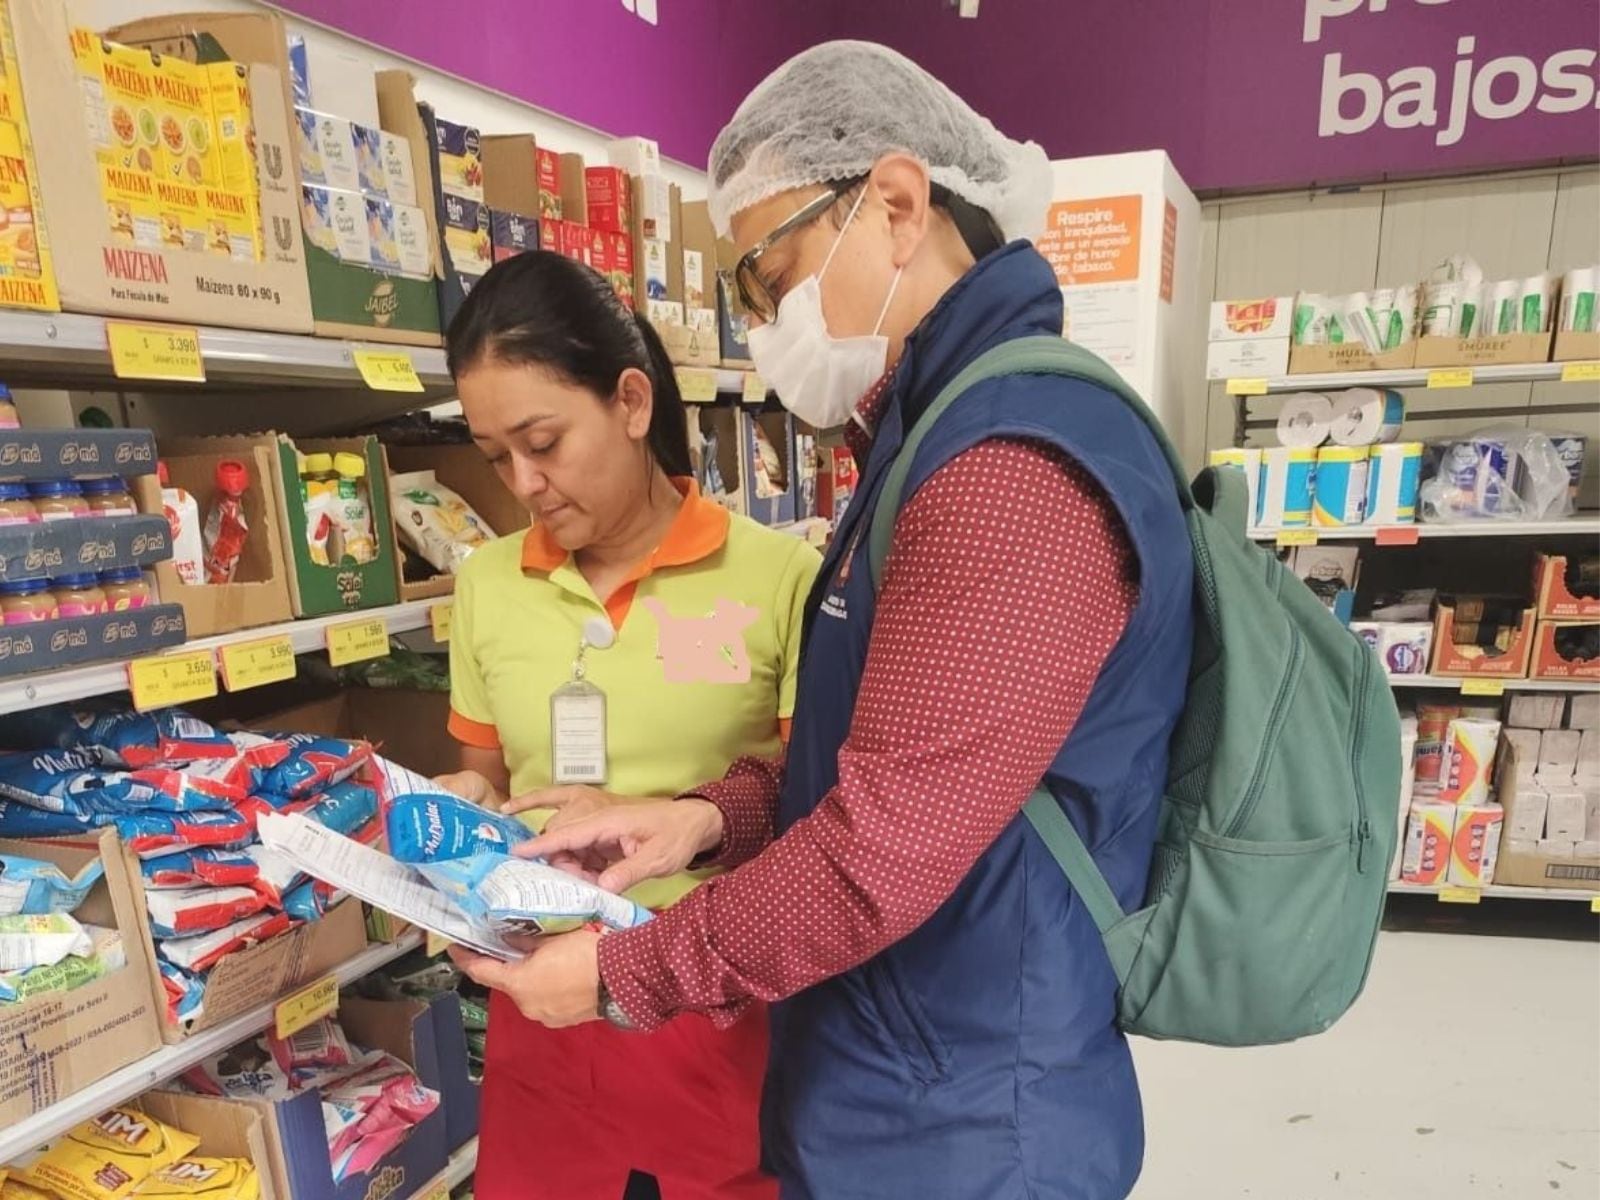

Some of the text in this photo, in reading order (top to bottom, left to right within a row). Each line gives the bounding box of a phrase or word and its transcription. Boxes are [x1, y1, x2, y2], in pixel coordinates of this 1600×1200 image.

[106, 168, 153, 197] MAIZENA
[157, 181, 199, 208] MAIZENA
[206, 190, 247, 214] MAIZENA
[1057, 208, 1113, 226] Respire
[102, 247, 169, 285] MAIZENA
[1091, 248, 1121, 260] humo
[0, 280, 47, 305] AIZENA
[364, 294, 399, 312] JAIBEL
